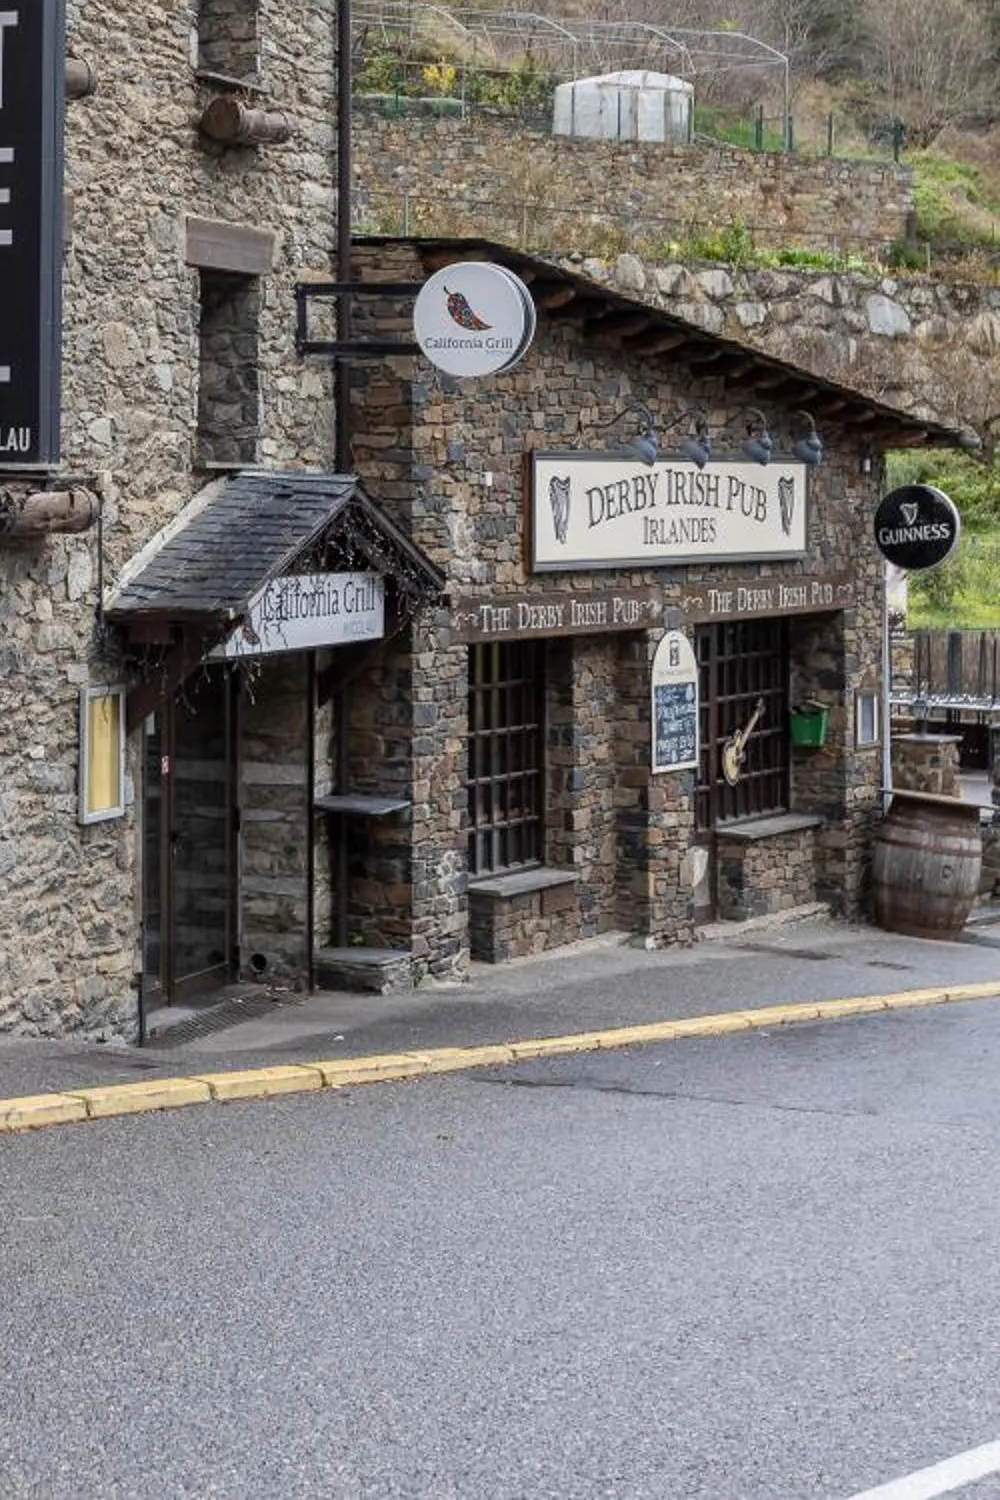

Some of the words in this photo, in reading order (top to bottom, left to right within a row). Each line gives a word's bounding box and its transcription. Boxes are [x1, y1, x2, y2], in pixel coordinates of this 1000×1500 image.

[424, 336, 483, 349] California
[486, 336, 514, 349] Grill
[584, 472, 660, 528] DERBY
[665, 468, 721, 509] IRISH
[726, 474, 768, 523] PUB
[642, 515, 718, 545] IRLANDES
[879, 523, 950, 545] GUINNESS
[343, 577, 376, 613] Grill
[708, 589, 733, 614] THE
[737, 587, 774, 612] DERBY
[778, 583, 807, 609] IRISH
[811, 581, 833, 605] PUB
[479, 604, 511, 633] THE
[517, 602, 565, 630] DERBY
[570, 599, 607, 627] IRISH
[612, 597, 639, 624] PUB
